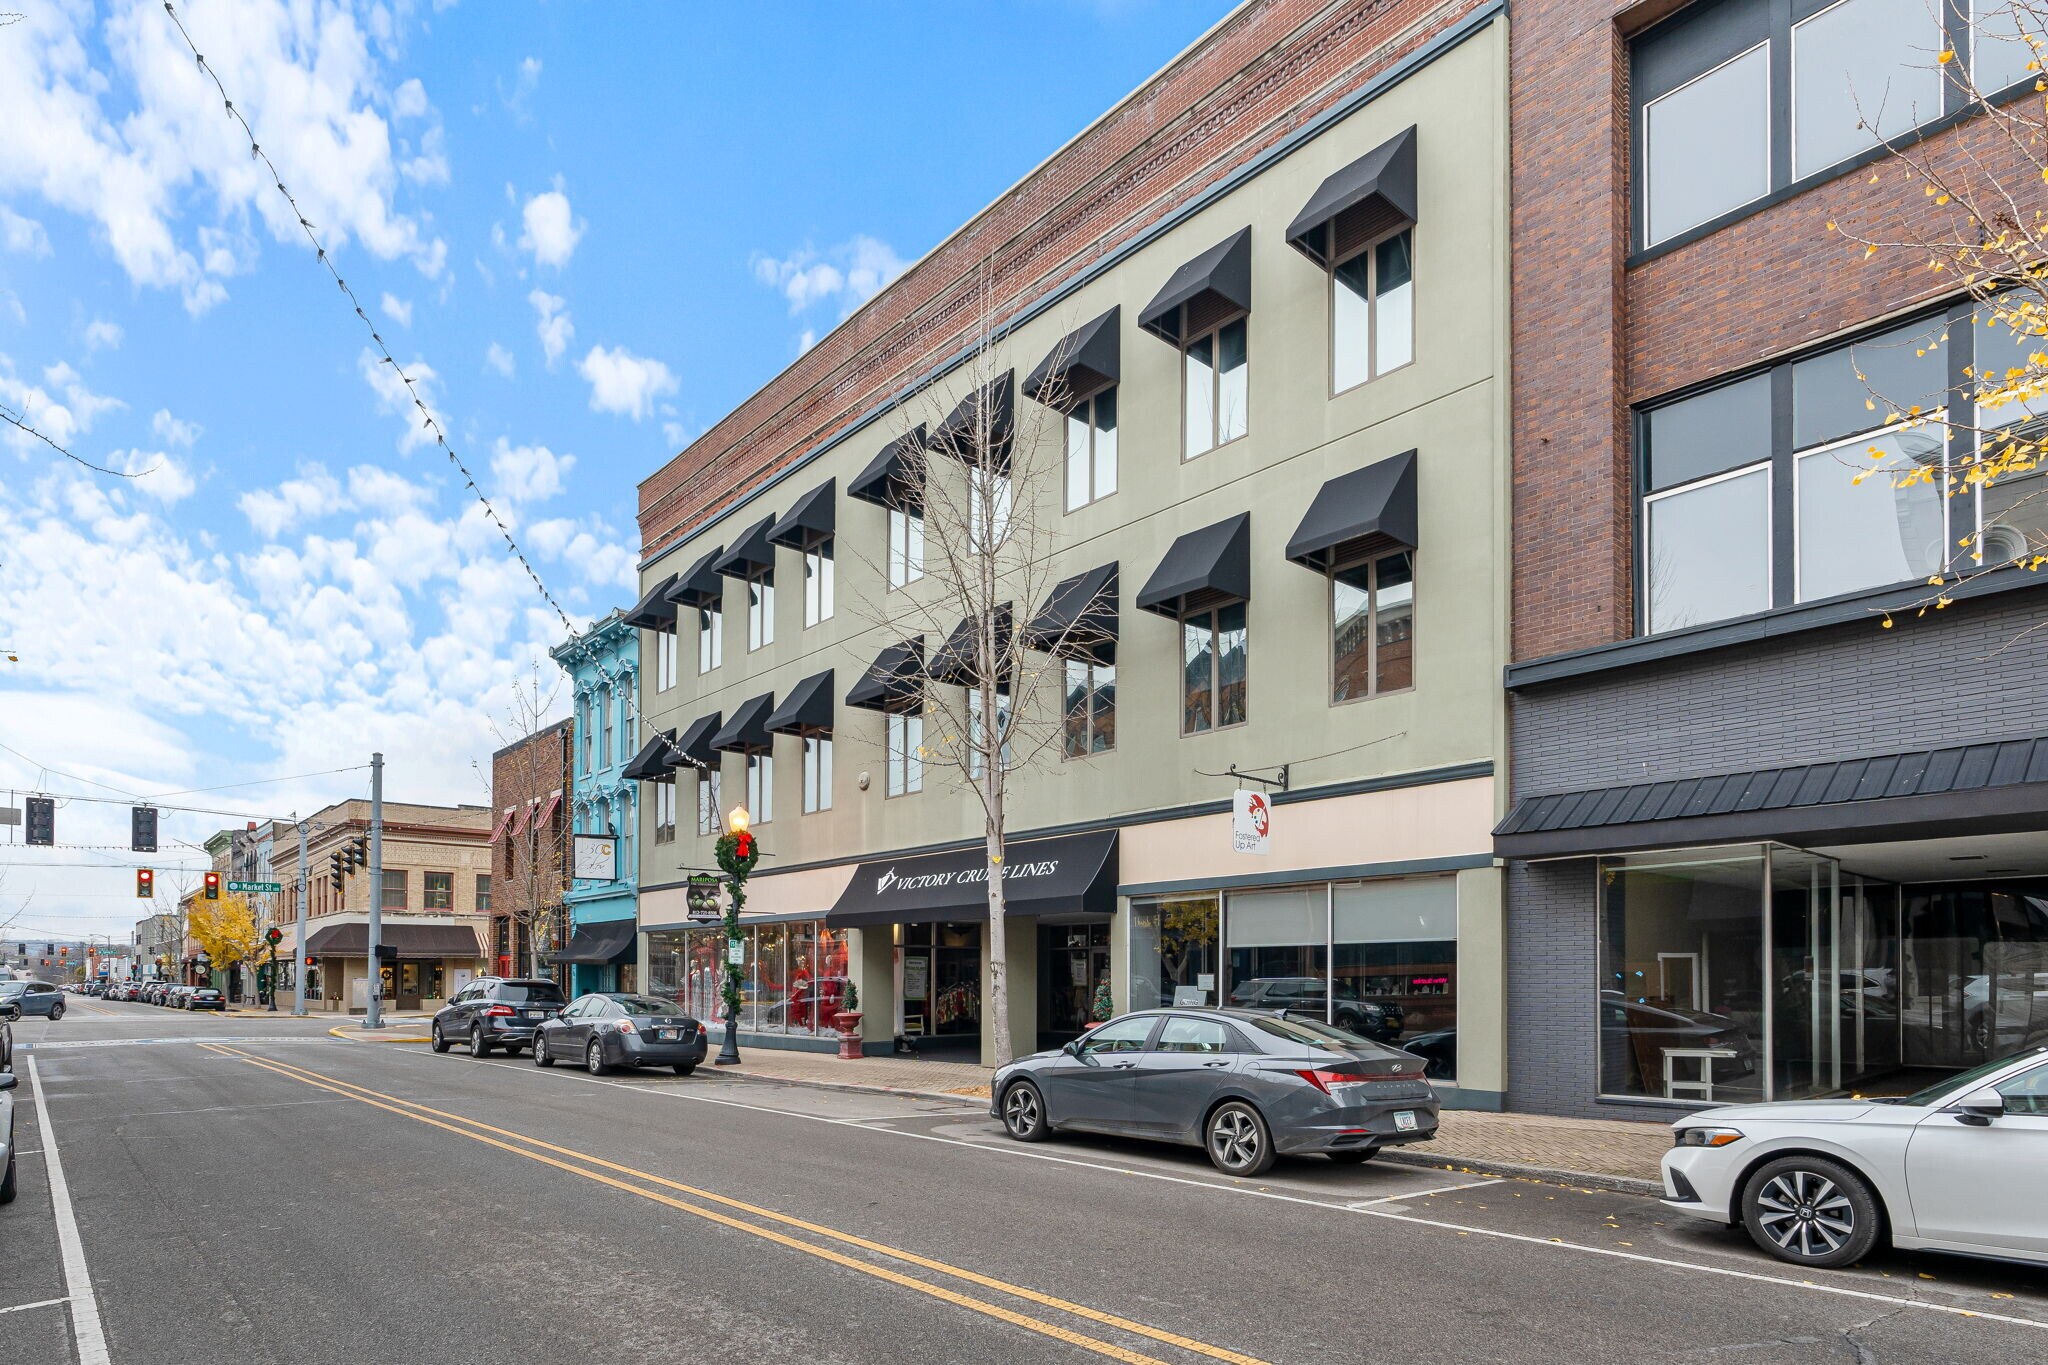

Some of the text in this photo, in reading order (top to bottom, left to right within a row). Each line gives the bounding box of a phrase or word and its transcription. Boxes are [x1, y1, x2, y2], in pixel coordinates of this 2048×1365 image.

[1235, 830, 1260, 842] Fostered
[1235, 840, 1256, 851] Up Art
[897, 860, 1059, 890] VICTORY CRUE LINES
[242, 883, 264, 891] Market
